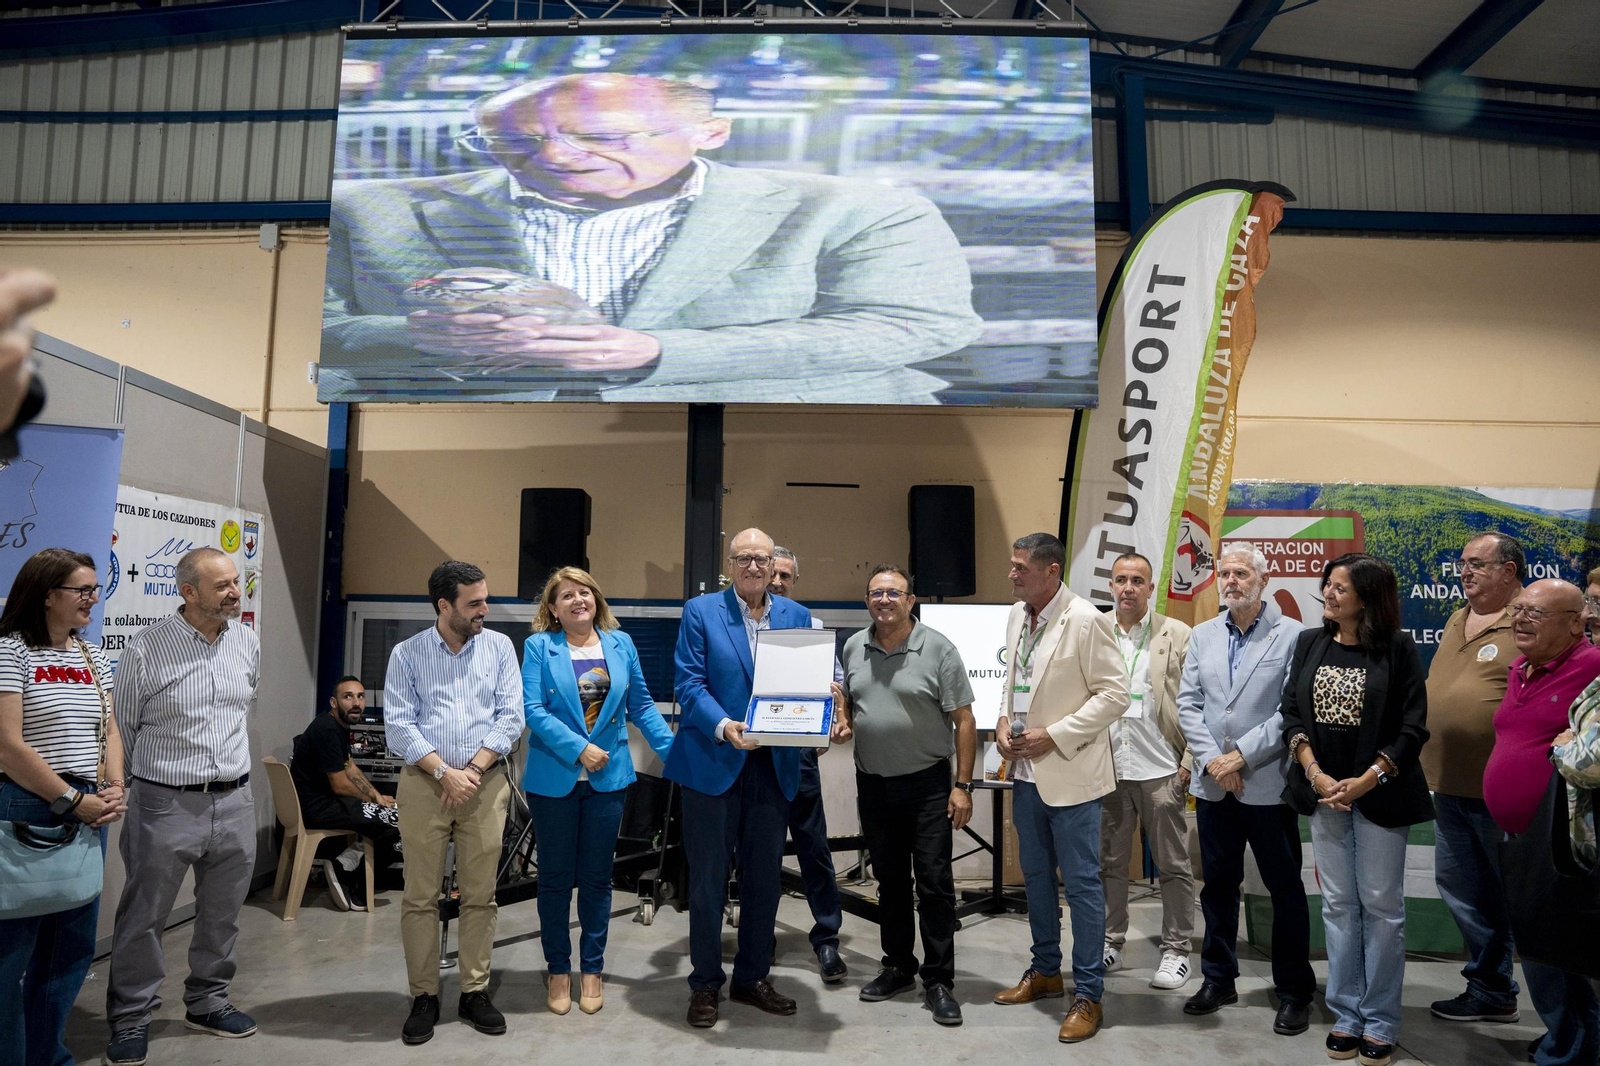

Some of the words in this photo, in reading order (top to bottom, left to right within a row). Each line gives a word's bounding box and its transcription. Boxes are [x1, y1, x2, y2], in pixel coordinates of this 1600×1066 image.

[1090, 264, 1186, 602] UTUASPORT
[138, 506, 150, 517] DE
[152, 509, 168, 520] LOS
[170, 512, 216, 528] CAZADORES
[1286, 559, 1306, 573] DE
[144, 582, 181, 596] MUTUA
